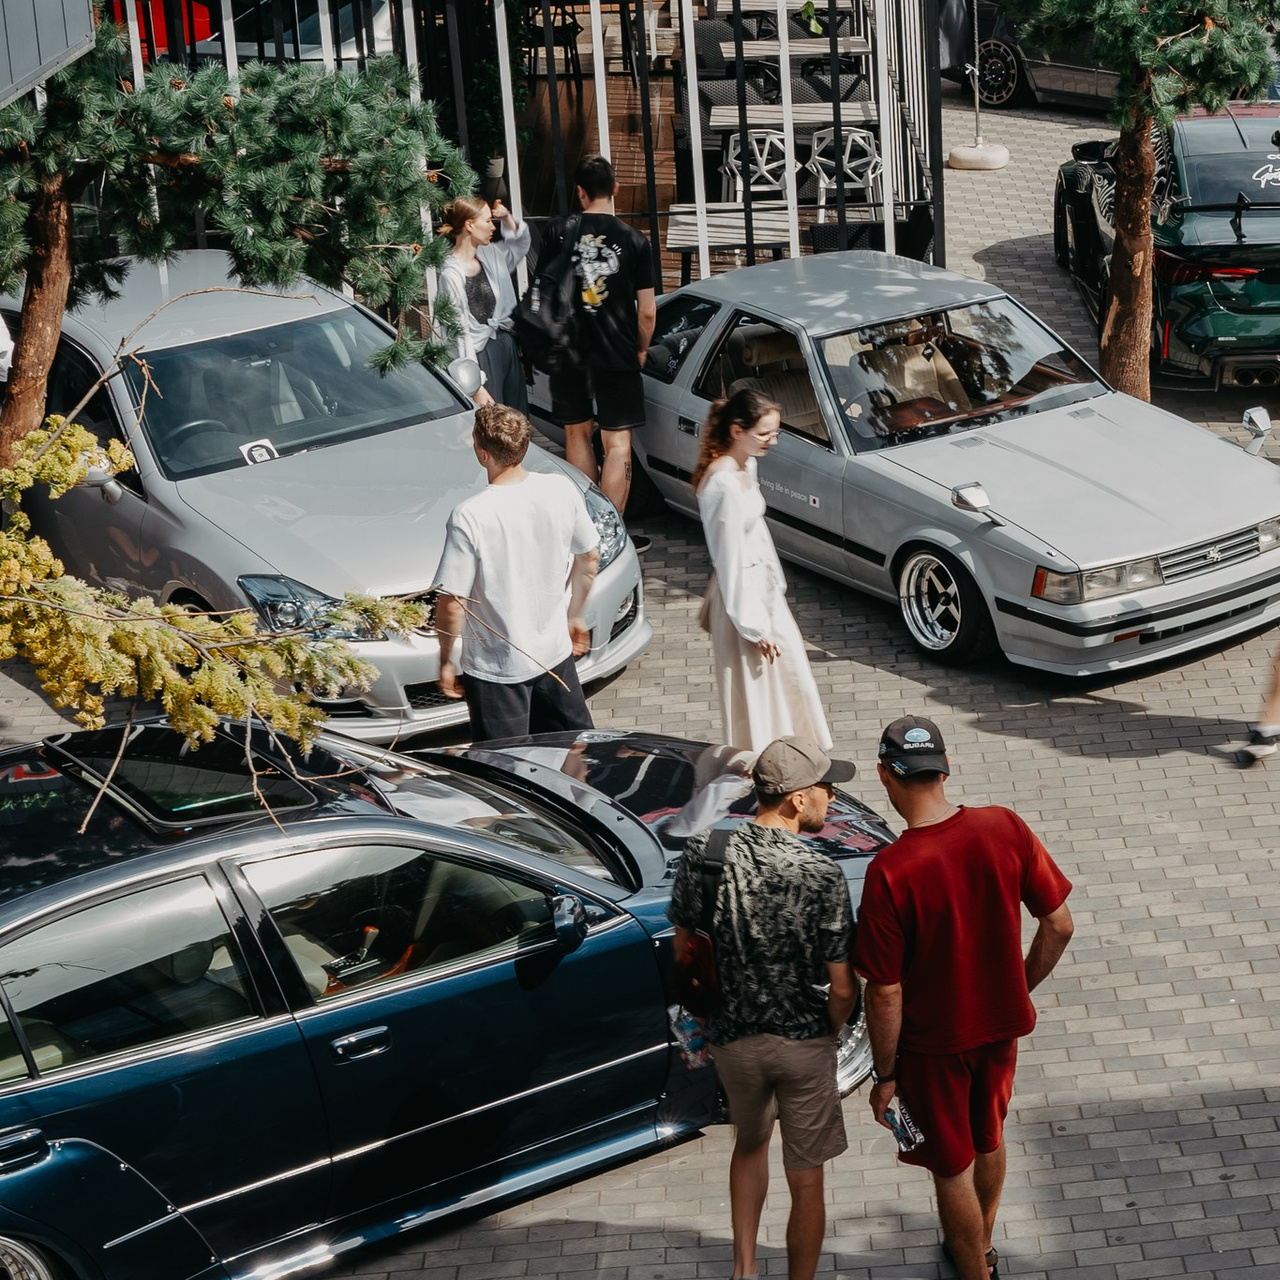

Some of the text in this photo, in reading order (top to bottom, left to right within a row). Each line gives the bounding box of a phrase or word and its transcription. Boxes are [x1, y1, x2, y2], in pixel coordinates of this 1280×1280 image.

[775, 482, 784, 493] life
[784, 486, 790, 495] in
[790, 490, 808, 502] peace
[903, 742, 935, 750] SUBARU
